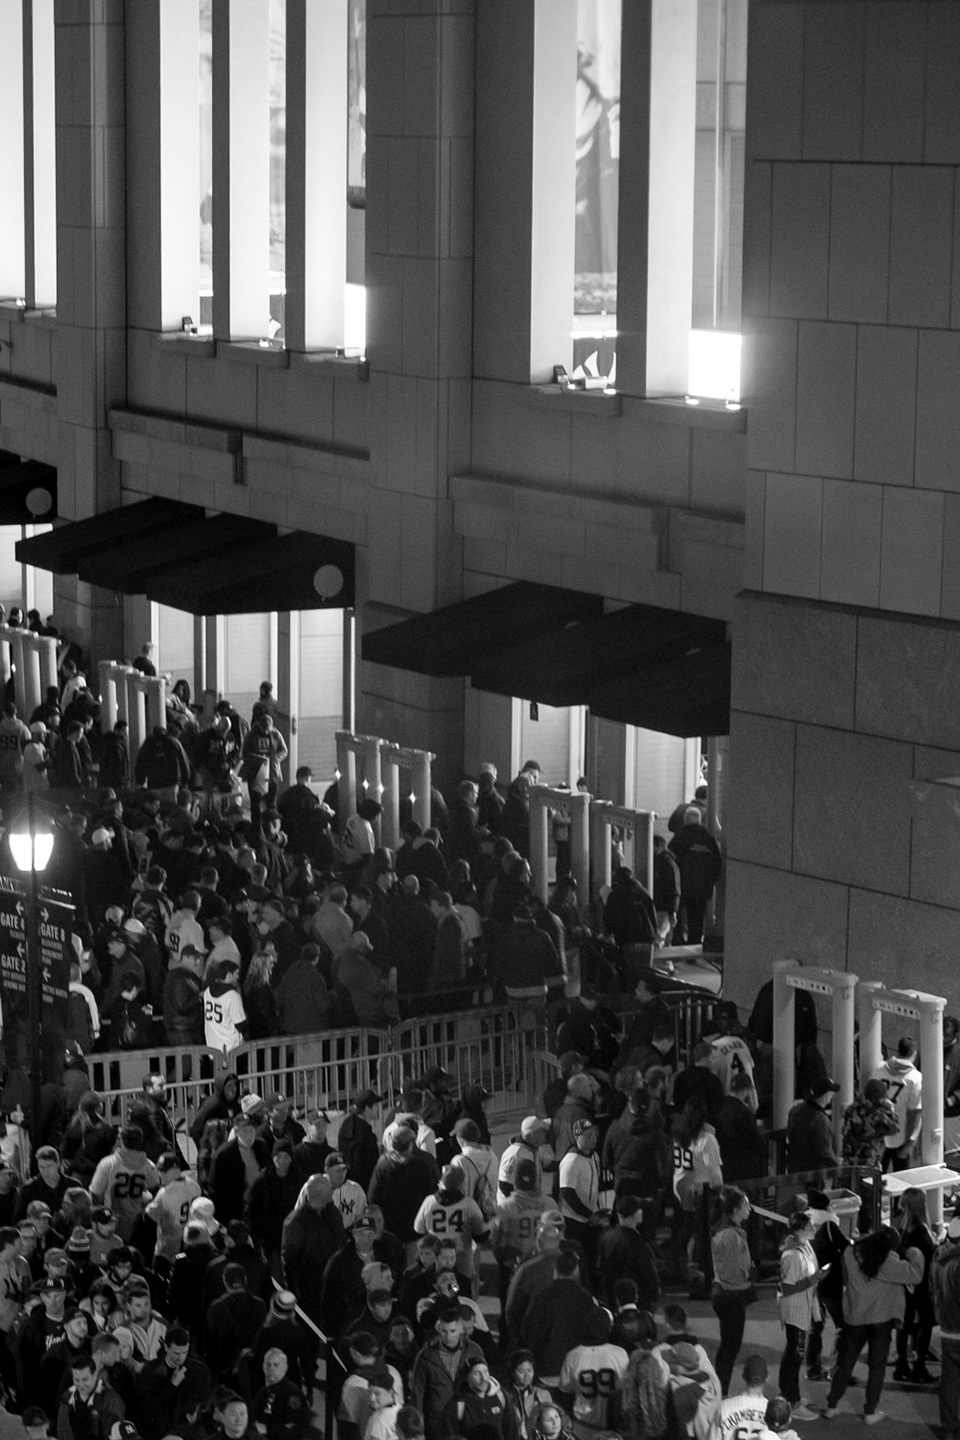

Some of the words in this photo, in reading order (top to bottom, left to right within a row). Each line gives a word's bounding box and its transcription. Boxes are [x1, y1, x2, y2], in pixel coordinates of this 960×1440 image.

[0, 911, 19, 930] GATE
[20, 917, 26, 931] 4
[40, 922, 59, 941] GATE
[1, 953, 20, 972] GATE
[20, 959, 26, 974] 2
[205, 1001, 223, 1023] 25
[731, 1051, 745, 1073] 4
[114, 1172, 146, 1198] 26
[432, 1209, 464, 1233] 24
[579, 1367, 616, 1400] 99
